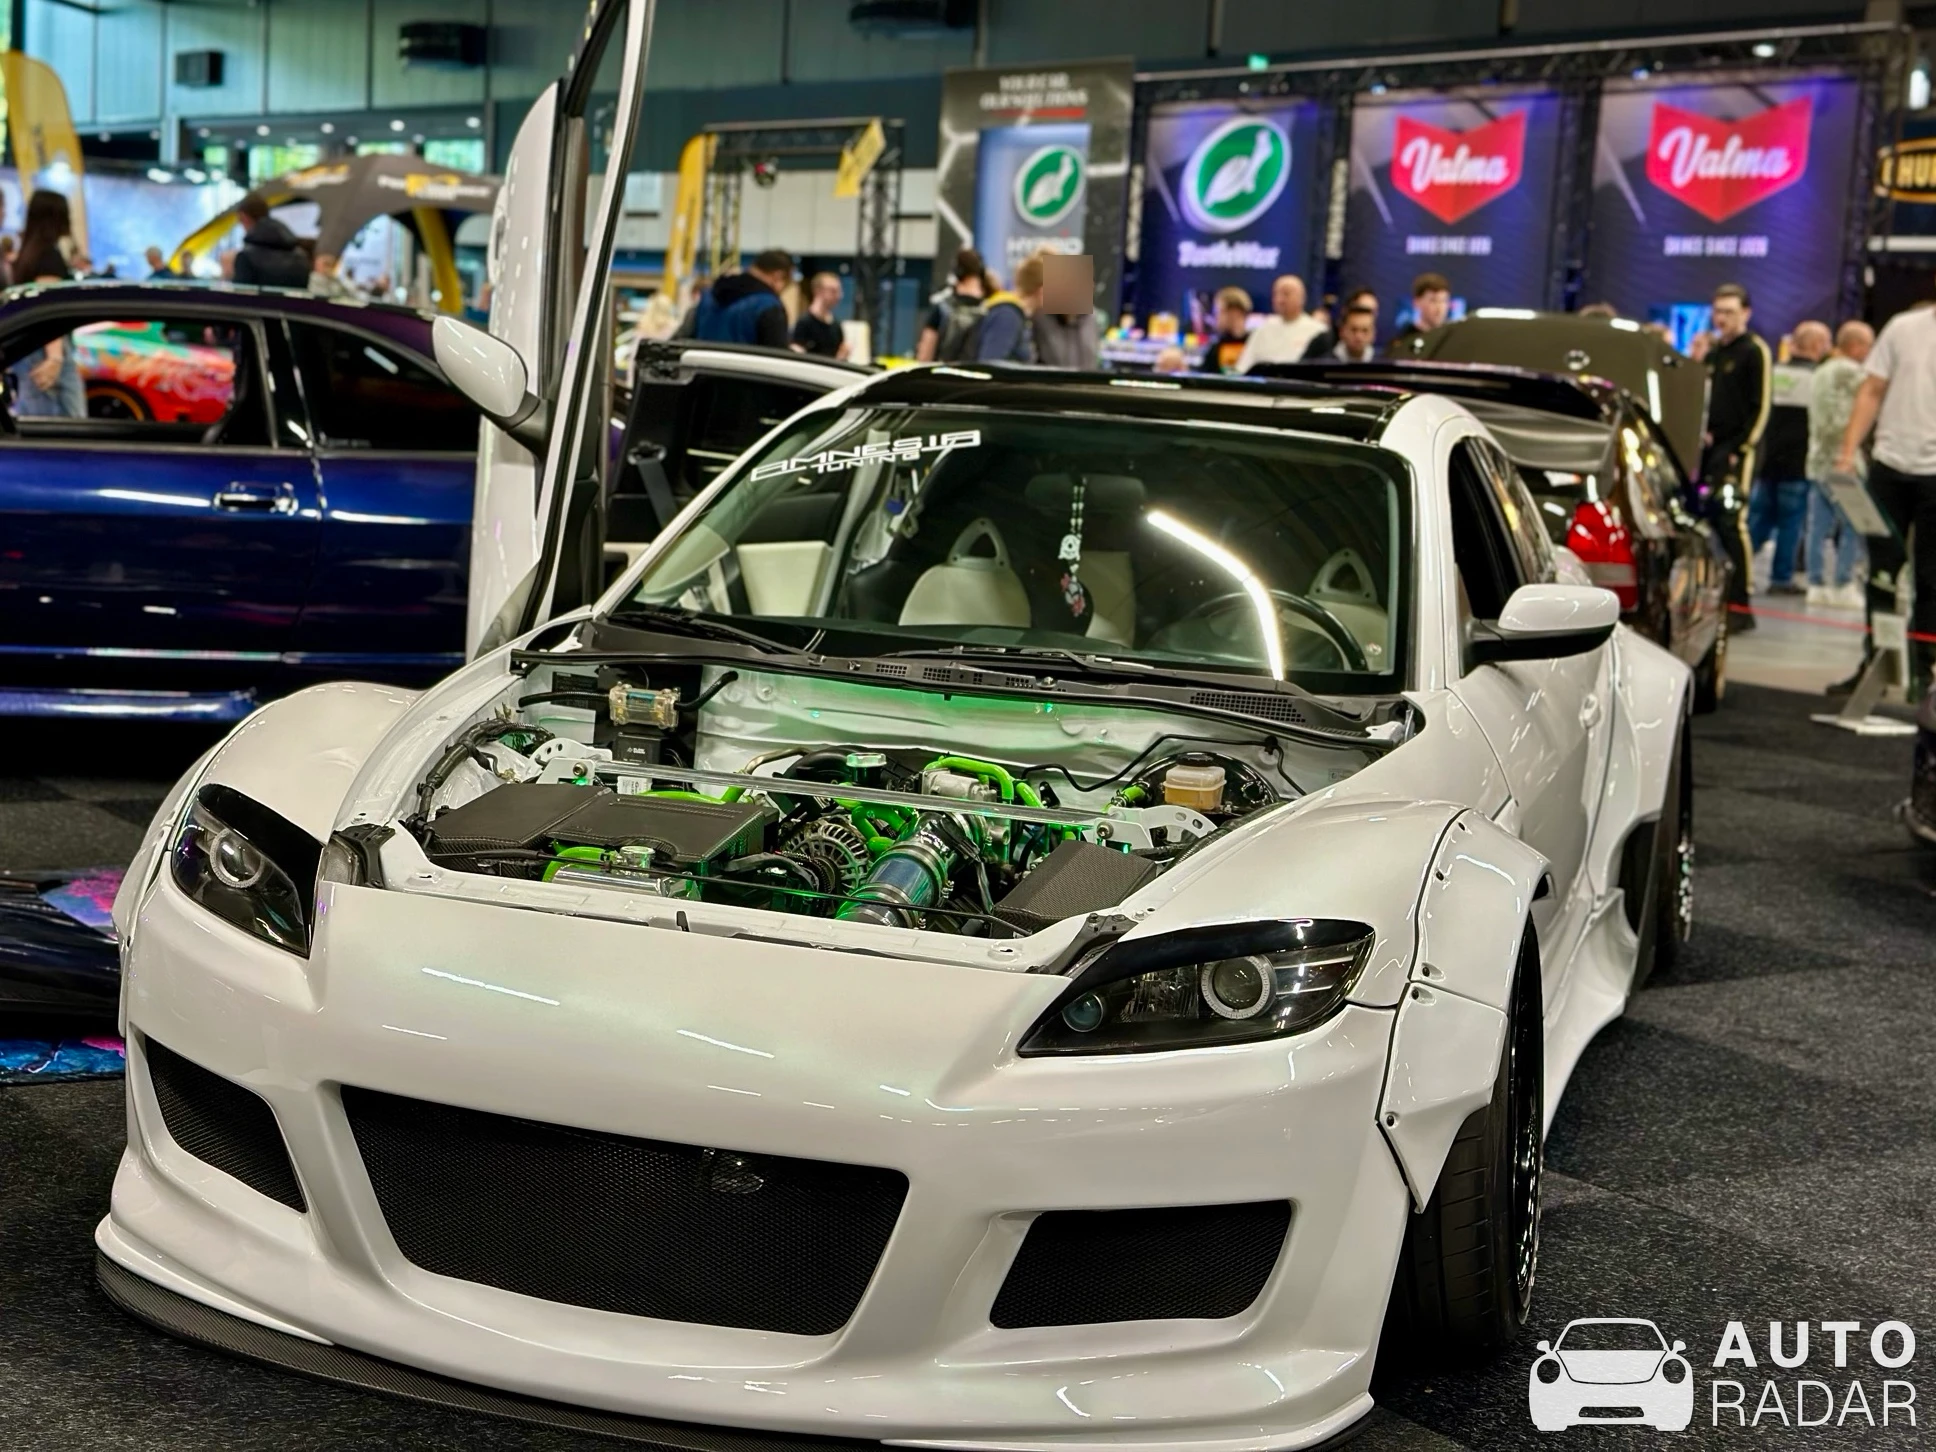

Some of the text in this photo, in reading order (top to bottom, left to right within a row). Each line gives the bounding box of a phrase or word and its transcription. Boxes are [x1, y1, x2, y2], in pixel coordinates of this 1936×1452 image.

[1401, 136, 1510, 193] Valma
[1657, 126, 1793, 188] Valma
[751, 429, 981, 482] AMNESIA
